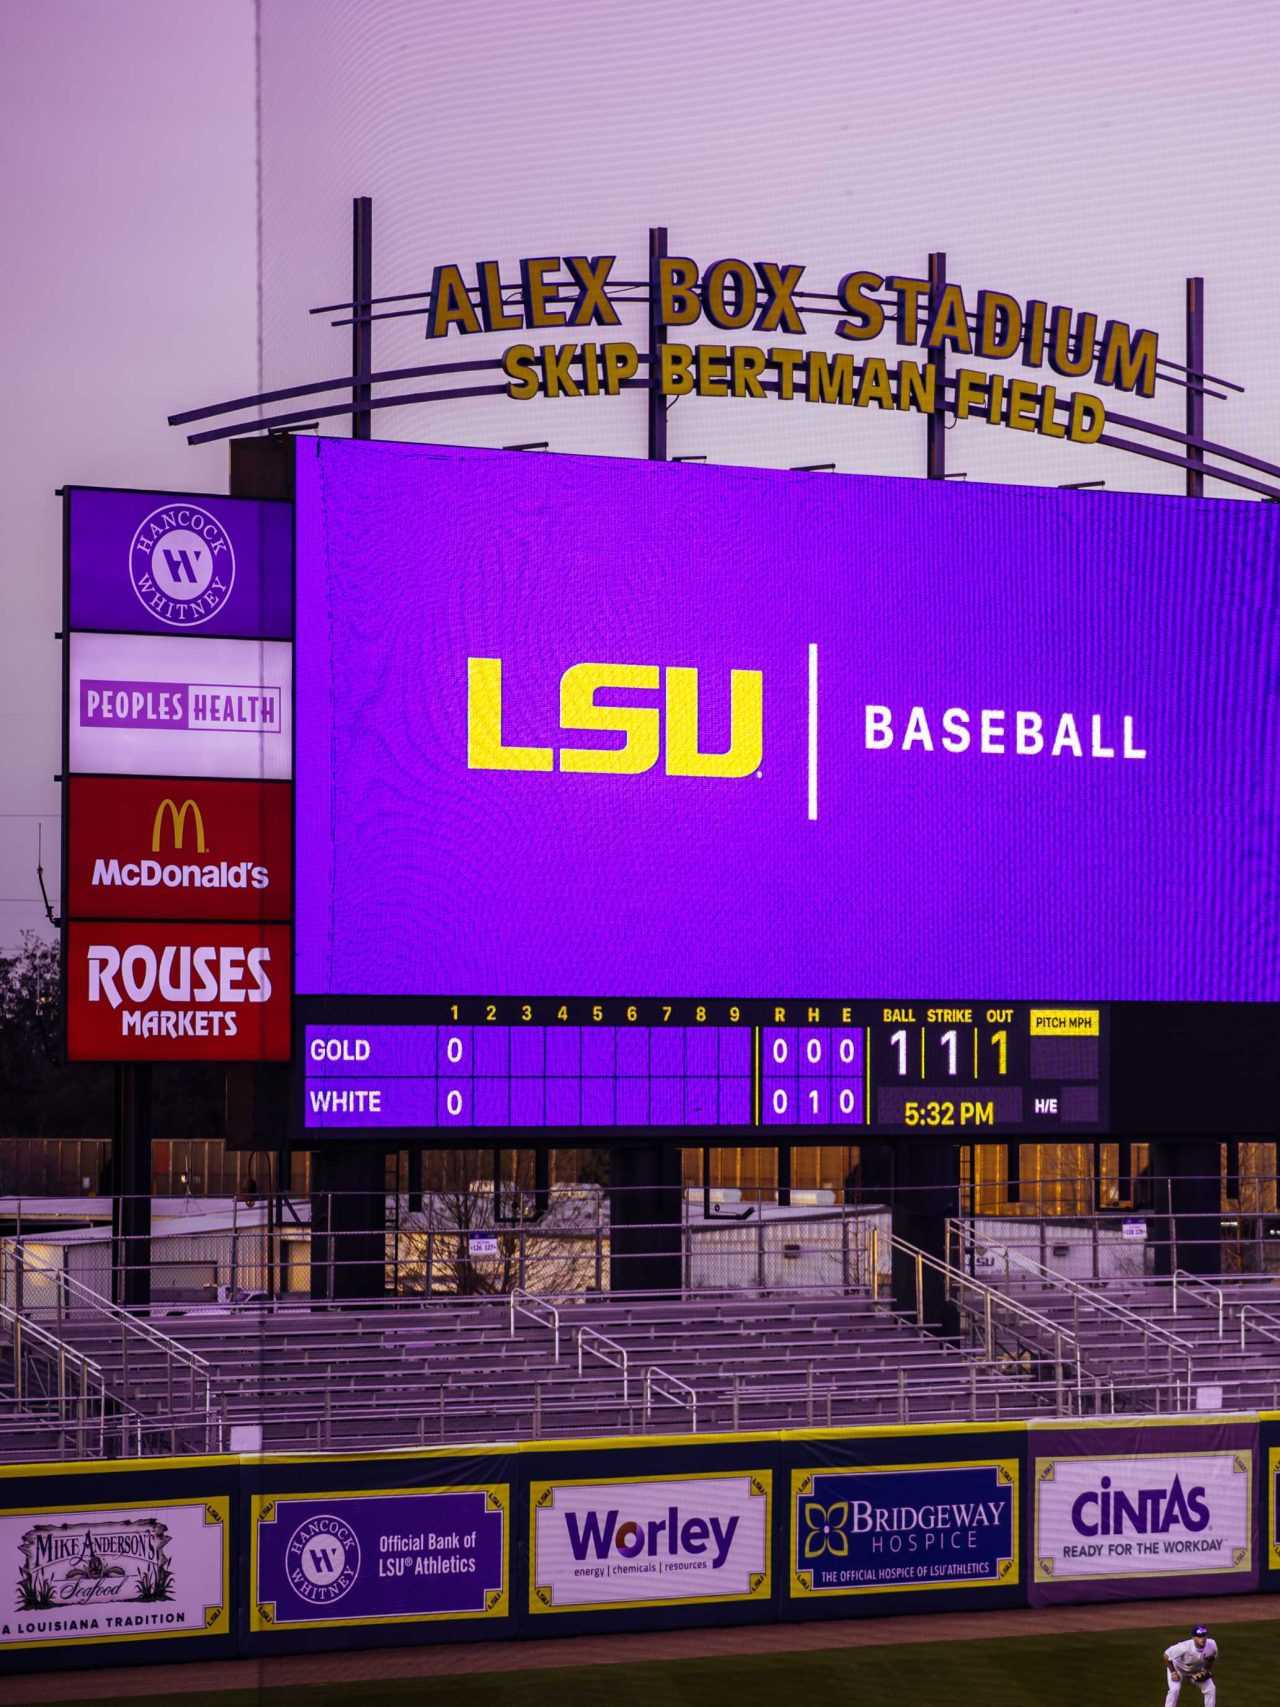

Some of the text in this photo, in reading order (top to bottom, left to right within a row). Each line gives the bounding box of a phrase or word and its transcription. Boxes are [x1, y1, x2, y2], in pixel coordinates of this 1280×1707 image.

[426, 255, 1160, 399] ALEX BOX STADIUM
[502, 341, 1107, 444] SKIP BERTMAN FIELD
[137, 511, 227, 556] HANCOCK
[137, 572, 227, 620] WHITNEY
[87, 689, 275, 724] PEOPLES HEALTH
[467, 657, 764, 779] LSU
[864, 704, 1147, 760] BASEBALL
[91, 858, 270, 889] McDonald's
[87, 944, 272, 1009] ROUSES
[121, 1010, 238, 1040] MARKETS
[450, 1006, 852, 1022] 1 2 3 4 5 6 7 8 9 R H E
[883, 1009, 1014, 1023] BALL STRIKE OUT
[1036, 1017, 1092, 1029] PITCH MPH
[310, 1039, 371, 1061] GOLD
[447, 1037, 854, 1064] 0 0 0 0
[890, 1030, 1007, 1075] 1 1 1
[310, 1090, 381, 1113] WHITE
[447, 1089, 854, 1116] 0 0 1 0
[904, 1102, 994, 1127] 5:32 PM
[1034, 1098, 1057, 1114] H/E
[850, 1500, 1005, 1533] BRIDGEWAY
[35, 1529, 160, 1567] MIKE ANDERSON'S
[291, 1520, 356, 1554] HANCOCK
[379, 1531, 477, 1552] Official Bank of
[564, 1506, 740, 1570] Worley
[872, 1530, 977, 1553] HOSPICE
[1063, 1539, 1222, 1558] READY FOR THE WORKDAY
[414, 1555, 477, 1575] Athletics
[574, 1560, 707, 1578] energy chemicals resources
[821, 1571, 838, 1583] THE
[840, 1569, 876, 1582] OFFICIAL
[878, 1567, 915, 1580] HOSPICE
[917, 1565, 928, 1577] OF
[60, 1576, 127, 1601] Seafood
[291, 1564, 356, 1600] WHITNEY
[1, 1612, 186, 1635] A LOUISIANA TRADITION
